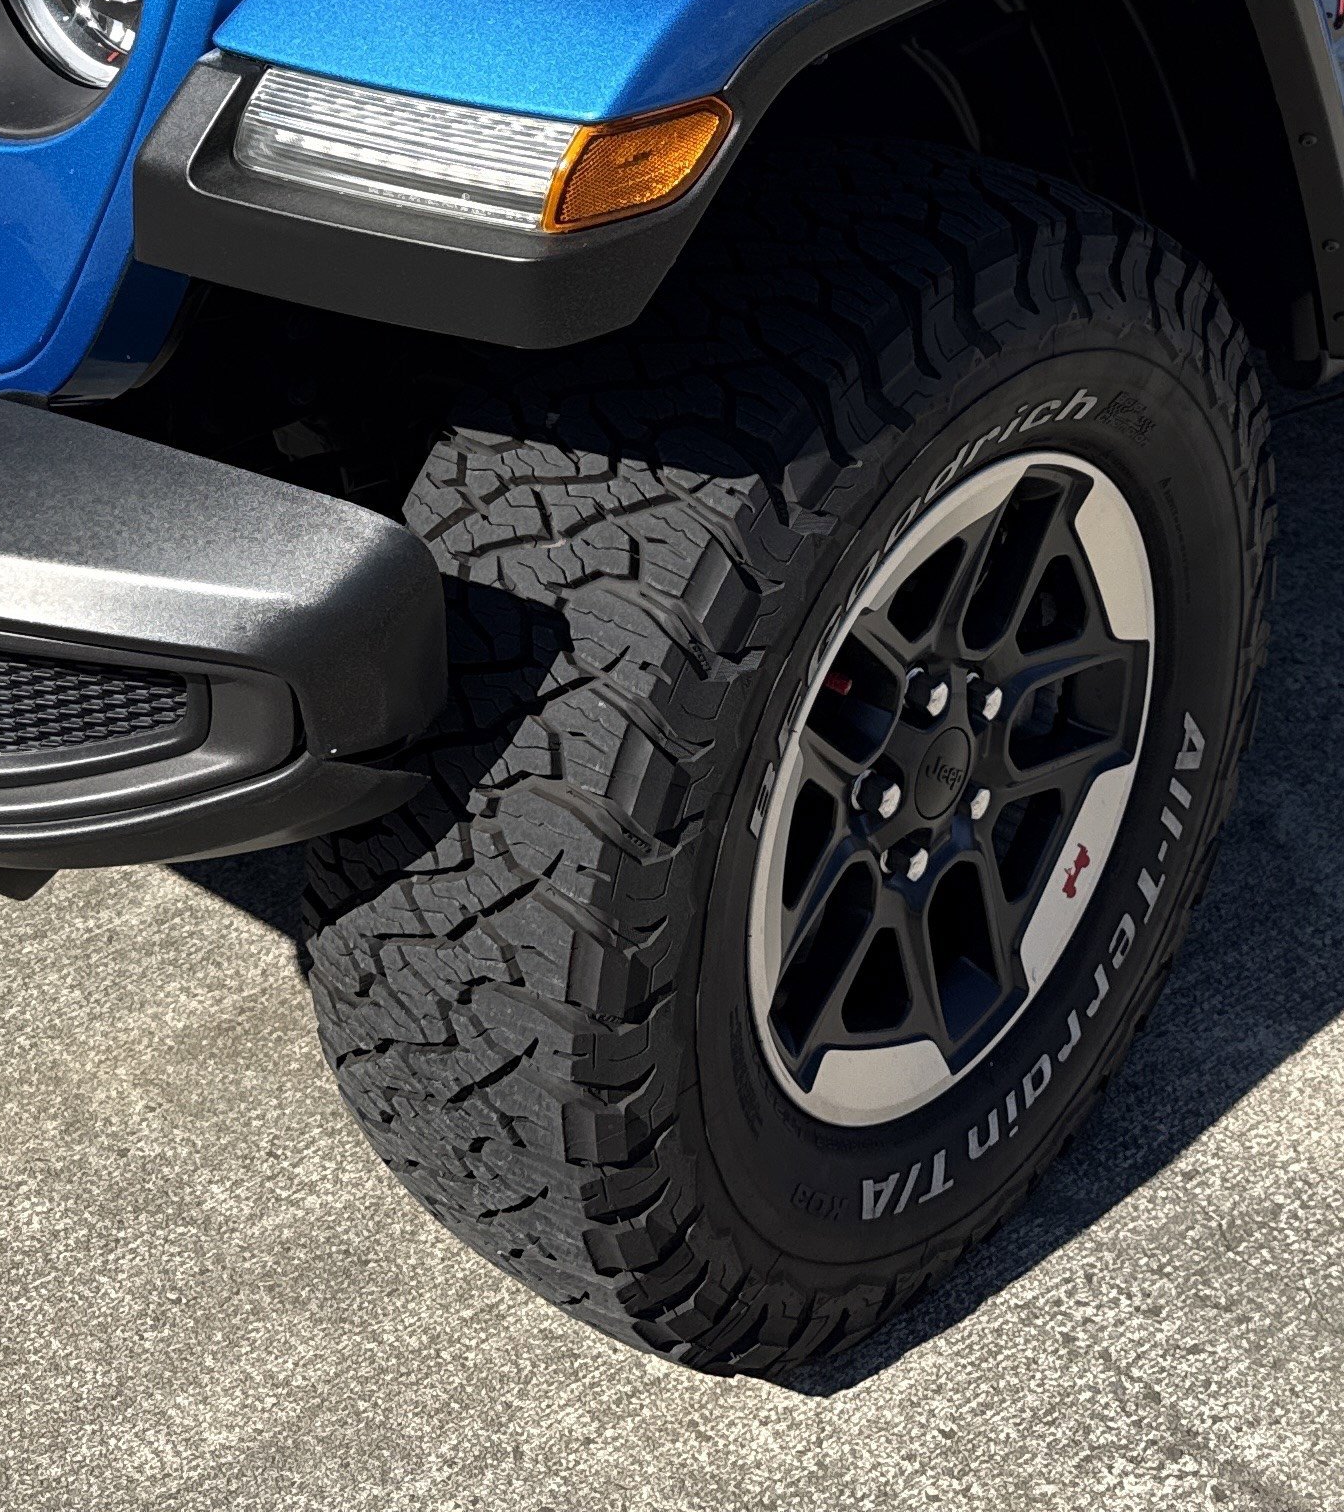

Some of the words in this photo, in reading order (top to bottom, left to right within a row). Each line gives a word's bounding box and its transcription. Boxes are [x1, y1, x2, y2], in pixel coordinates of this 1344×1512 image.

[925, 756, 963, 791] Jeep
[967, 711, 1206, 1161] All-Terrain
[861, 1148, 955, 1220] T/A
